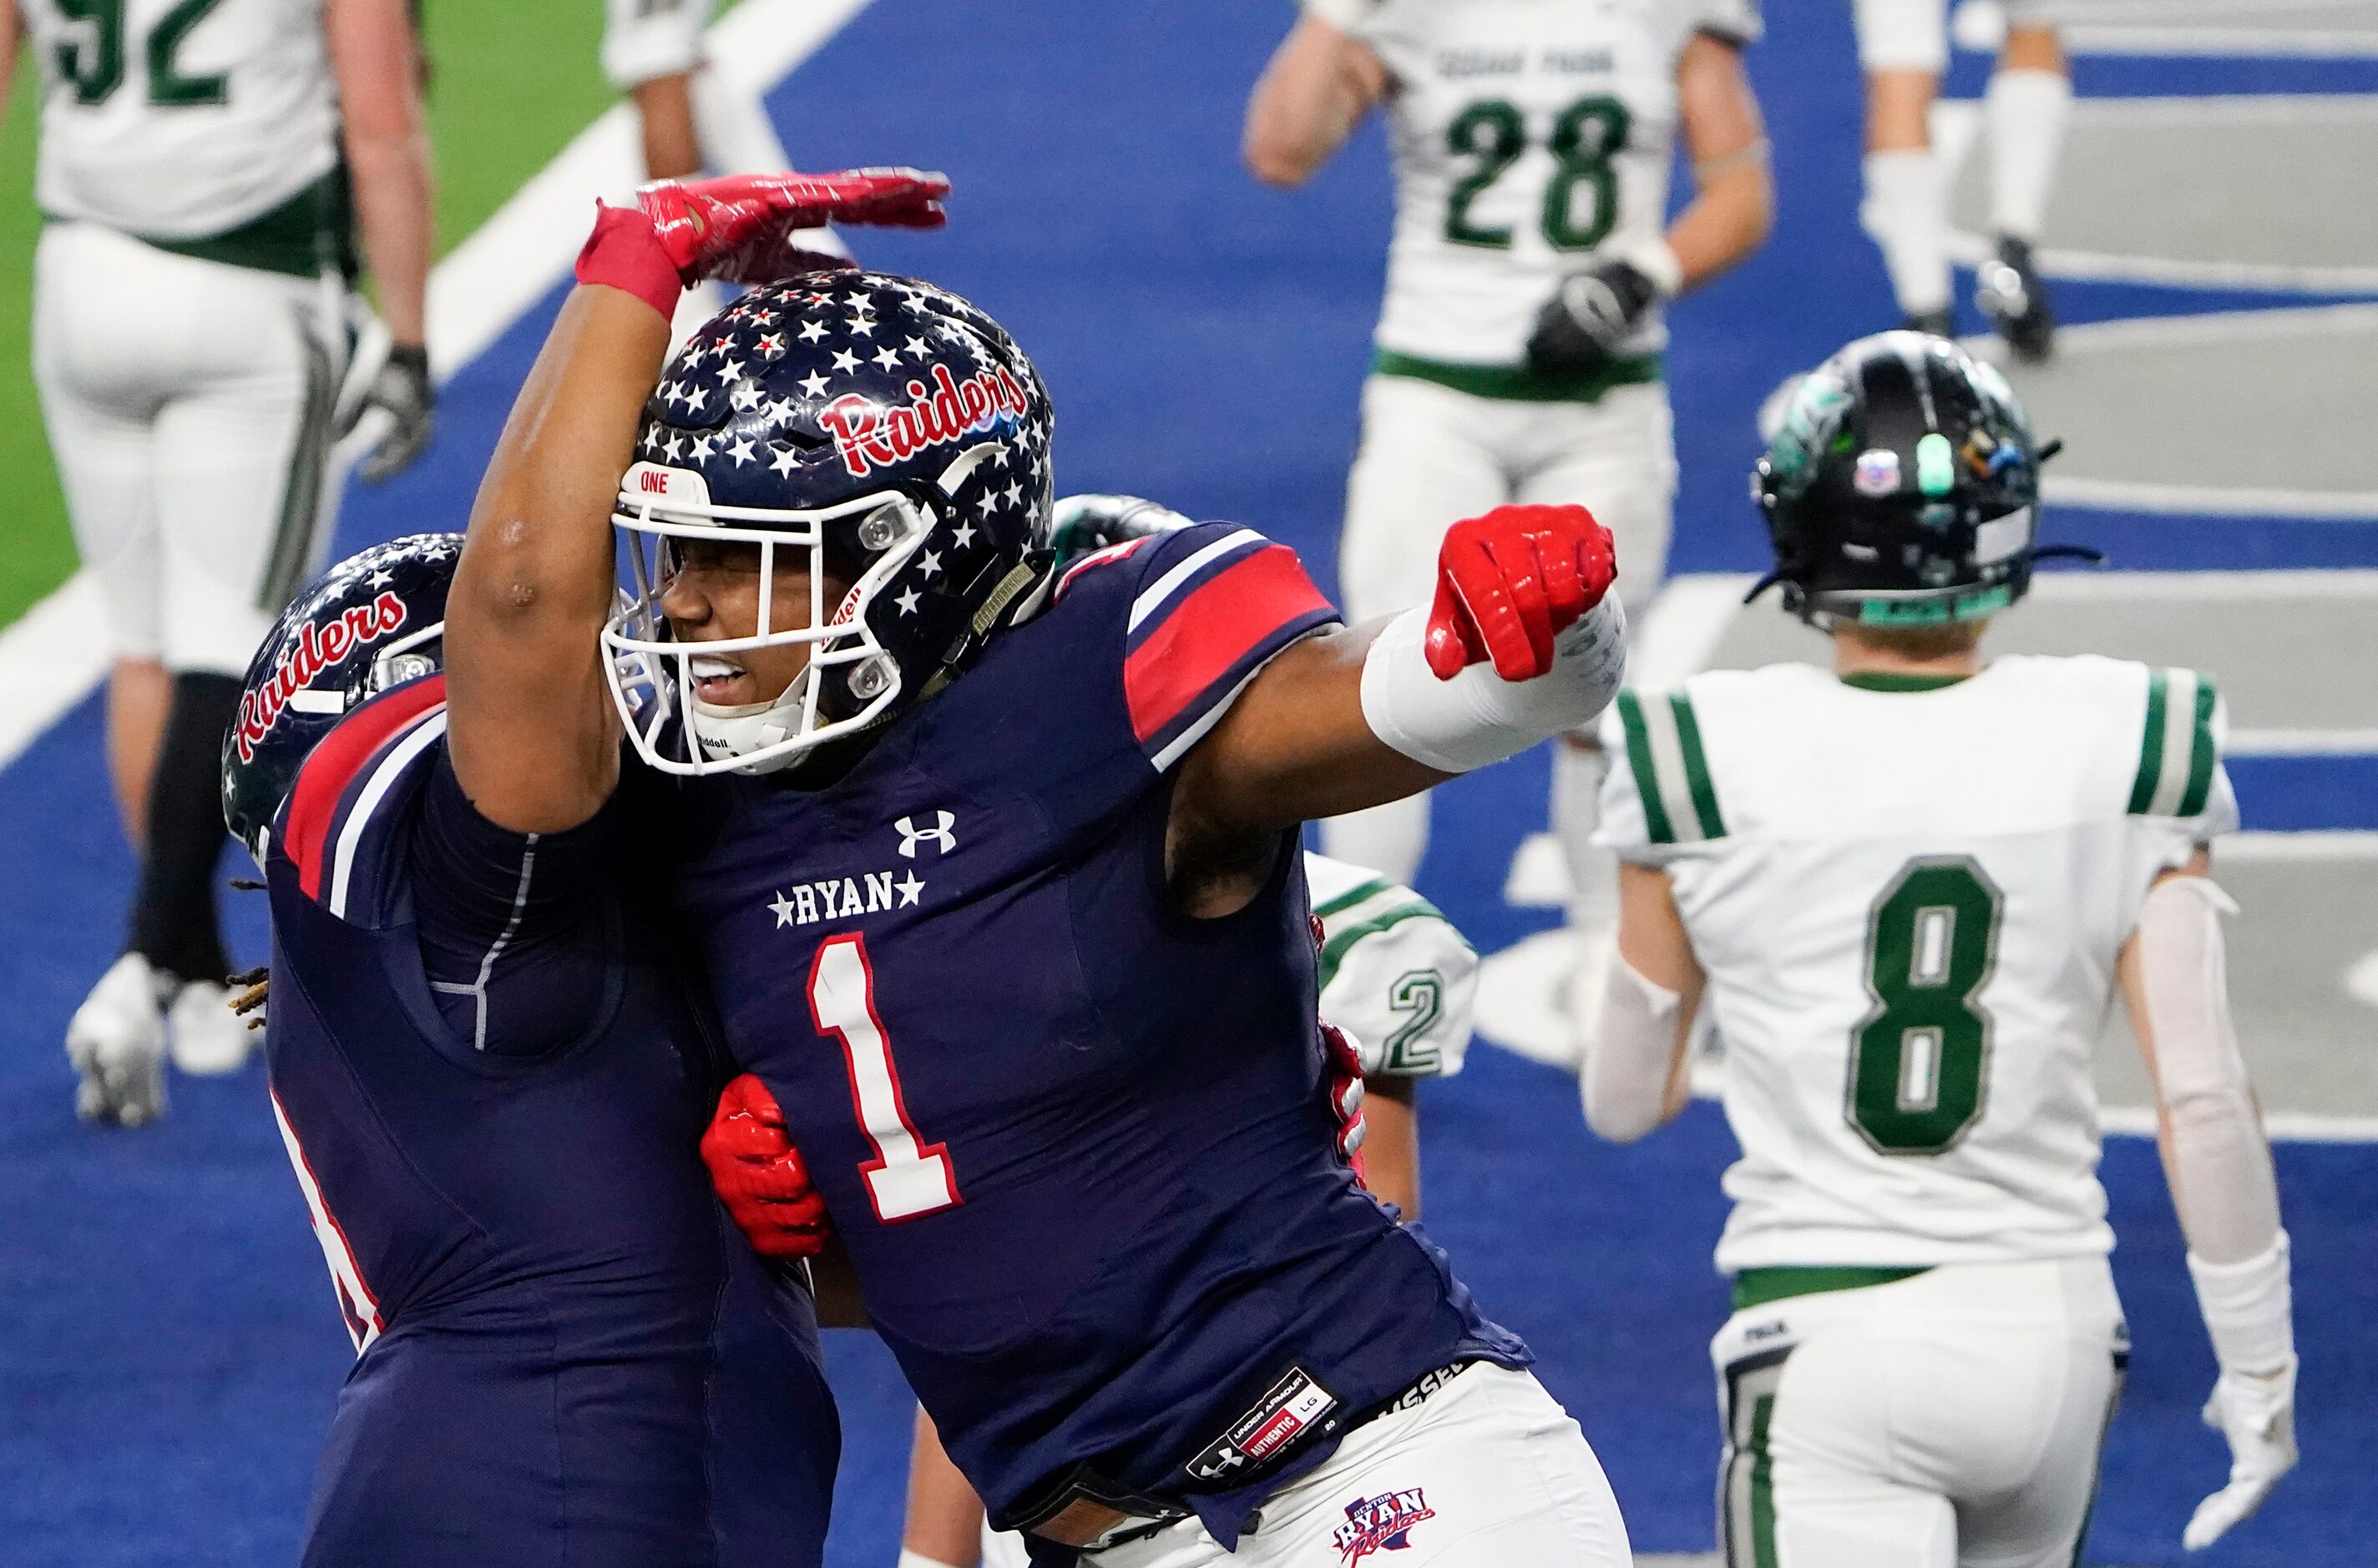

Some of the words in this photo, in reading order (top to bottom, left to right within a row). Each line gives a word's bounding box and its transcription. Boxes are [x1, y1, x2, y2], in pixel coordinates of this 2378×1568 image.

[1445, 94, 1629, 251] 28
[817, 362, 1028, 478] Raiders
[640, 471, 669, 494] ONE
[237, 590, 407, 766] Raiders
[792, 871, 893, 925] RYAN
[1379, 969, 1444, 1076] 2
[1843, 853, 2006, 1156] 8
[806, 930, 966, 1225] 1
[1233, 1411, 1265, 1439] UNDER
[1265, 1377, 1303, 1413] ARMOUR
[1300, 1396, 1318, 1413] LG
[1324, 1419, 1336, 1431] 20
[1250, 1415, 1296, 1457] AUTHENTIC
[1335, 1489, 1424, 1550] RYAN
[1353, 1493, 1392, 1518] DENTON
[1341, 1508, 1435, 1568] Raiders
